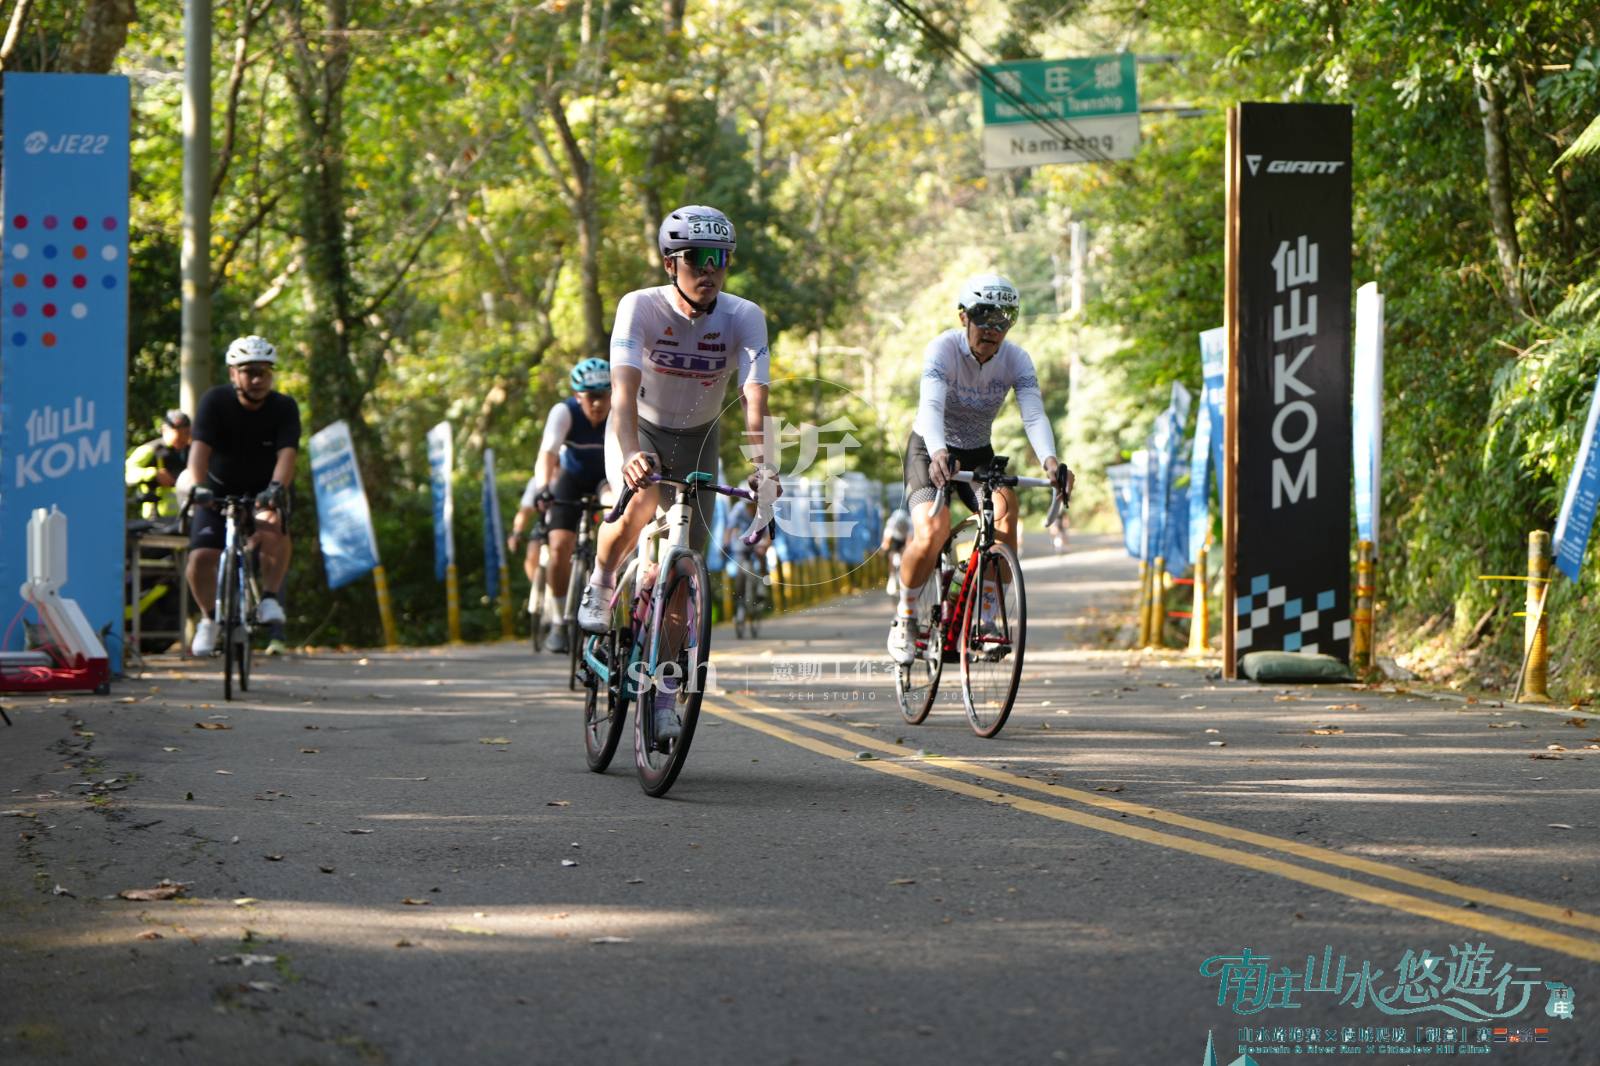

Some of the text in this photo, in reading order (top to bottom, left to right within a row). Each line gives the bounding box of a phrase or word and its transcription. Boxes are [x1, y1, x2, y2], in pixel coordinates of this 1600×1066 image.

[49, 134, 109, 154] JE22
[1266, 161, 1344, 174] GIANT
[651, 351, 725, 370] RTT
[25, 396, 95, 446] 仙山
[15, 430, 112, 488] KOM
